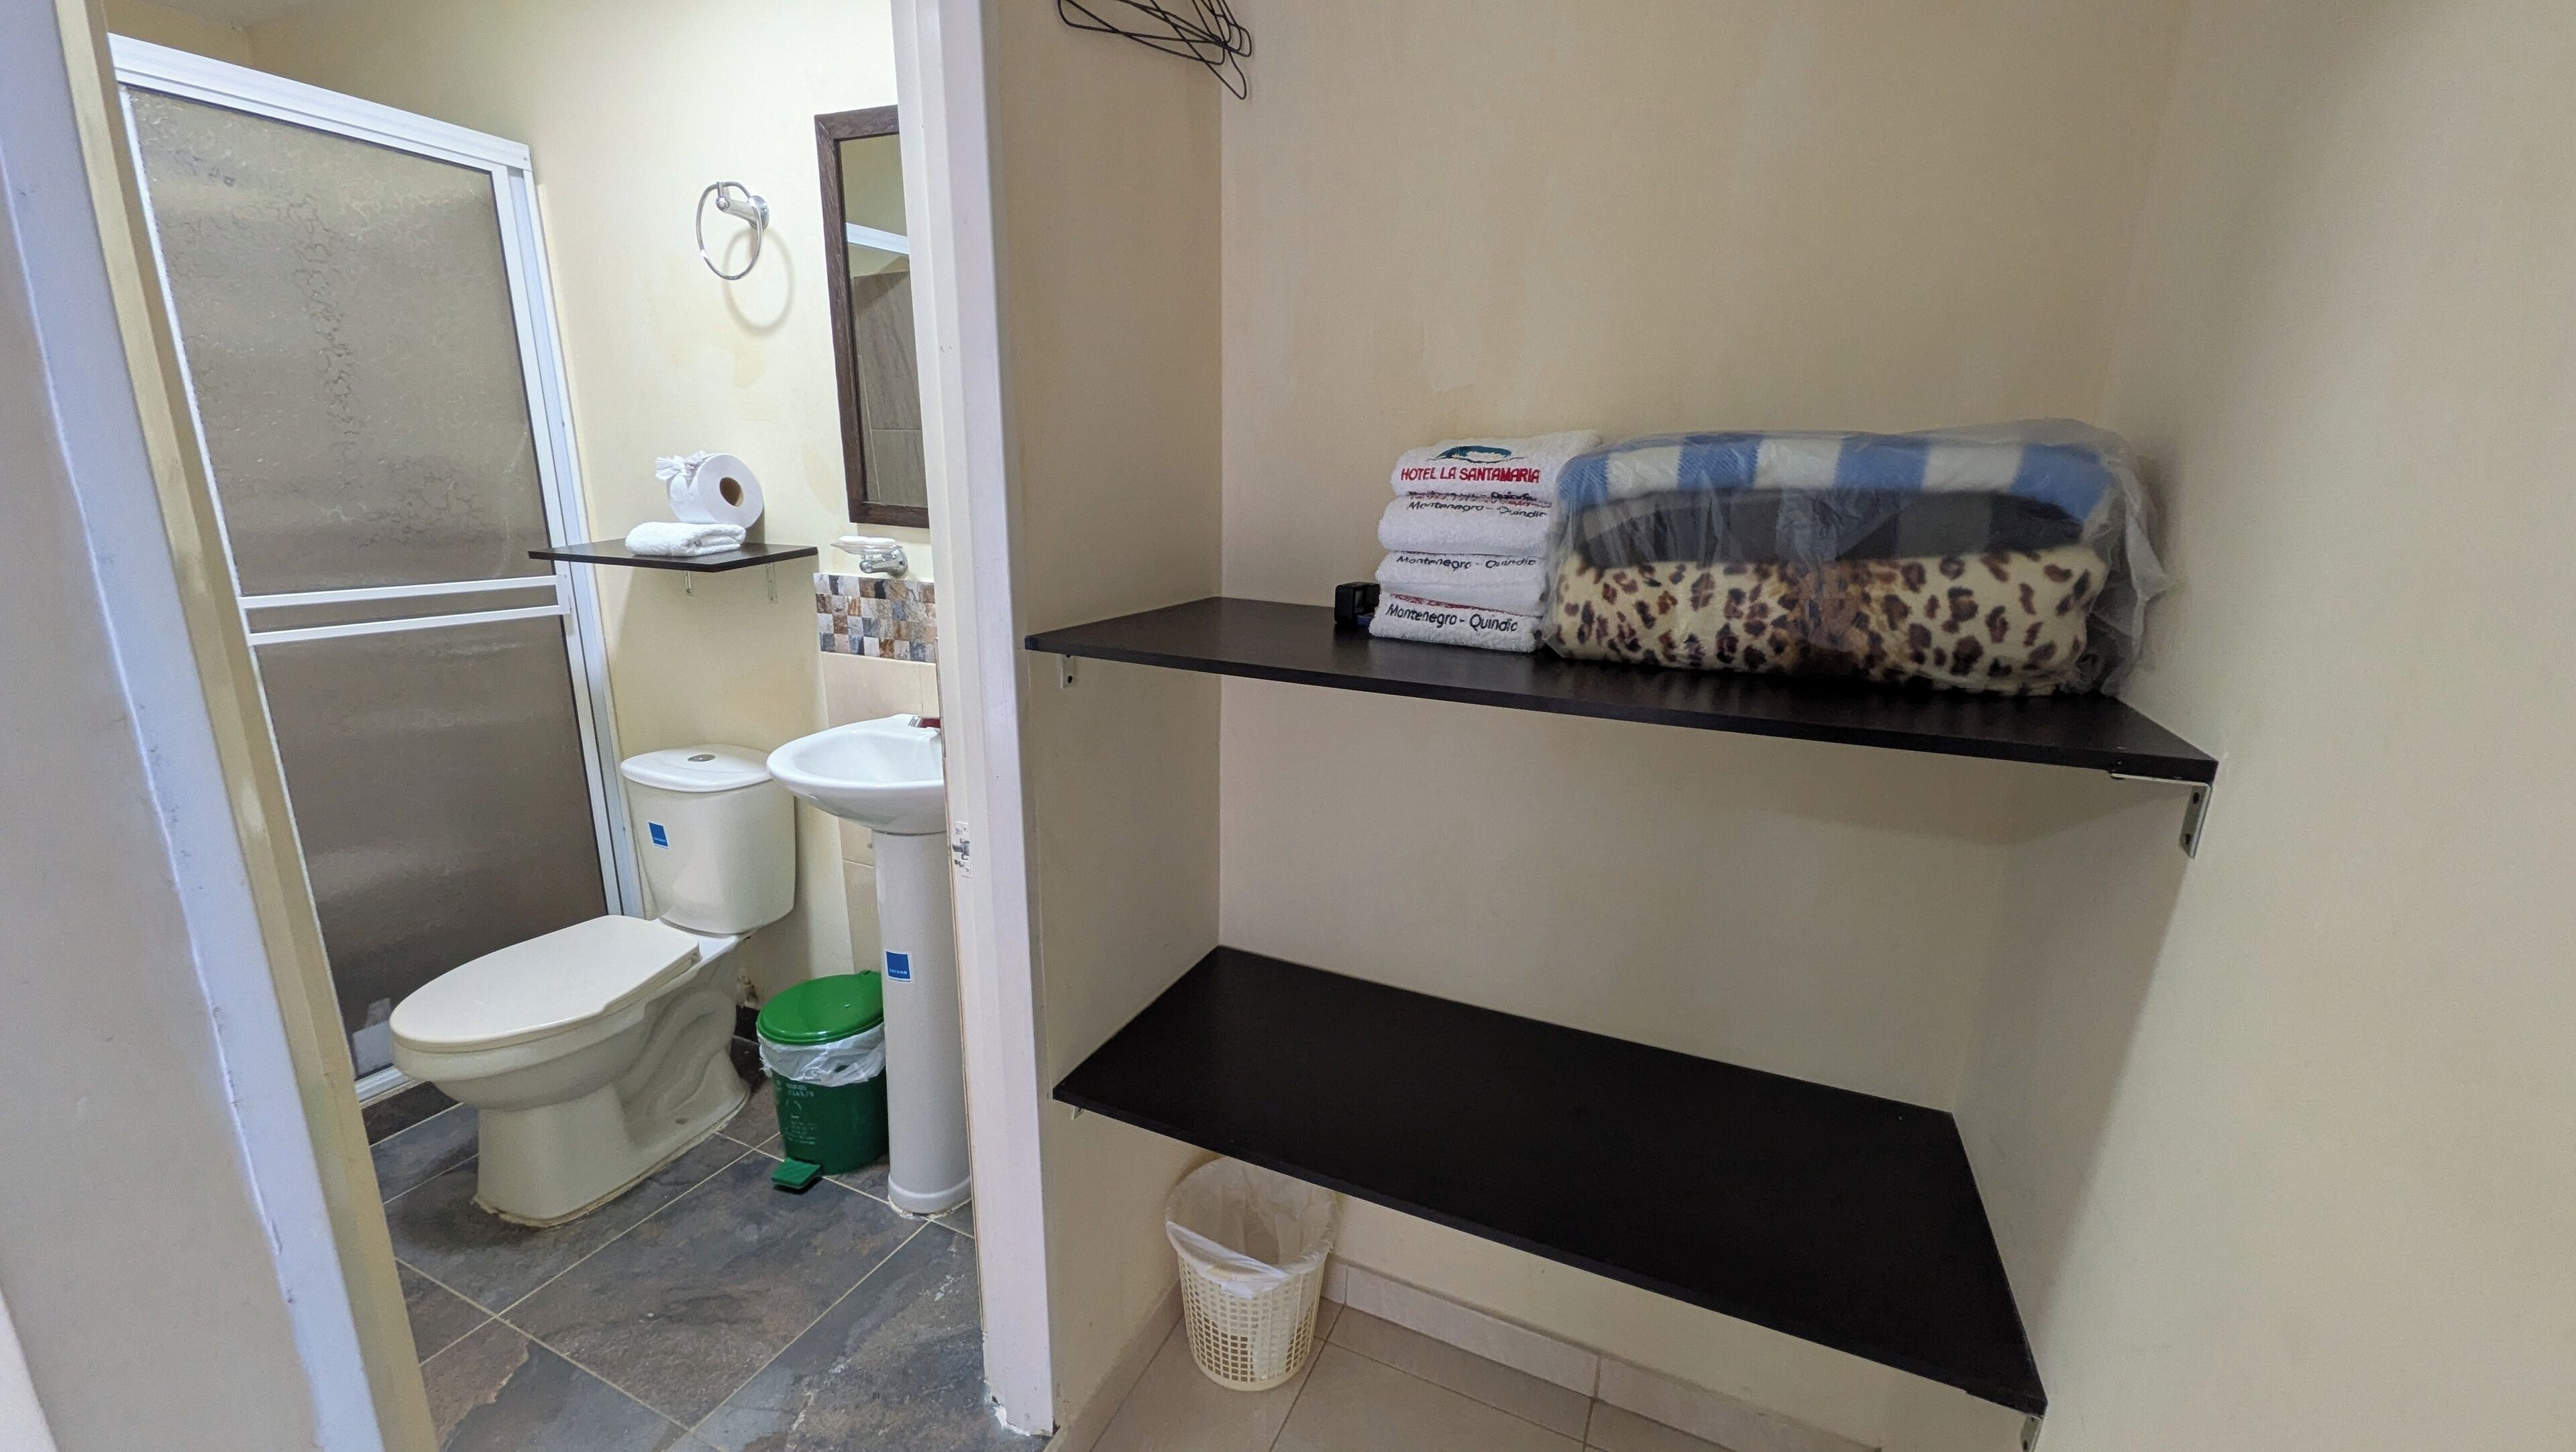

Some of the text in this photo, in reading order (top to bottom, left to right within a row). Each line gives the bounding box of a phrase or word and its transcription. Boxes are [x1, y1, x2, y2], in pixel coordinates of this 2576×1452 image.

[1401, 467, 1540, 483] HOTEL LA SANTAMARIA
[1407, 501, 1484, 512] Montenegro
[1396, 556, 1472, 571] Montenegro
[1385, 604, 1457, 628] Montenegro
